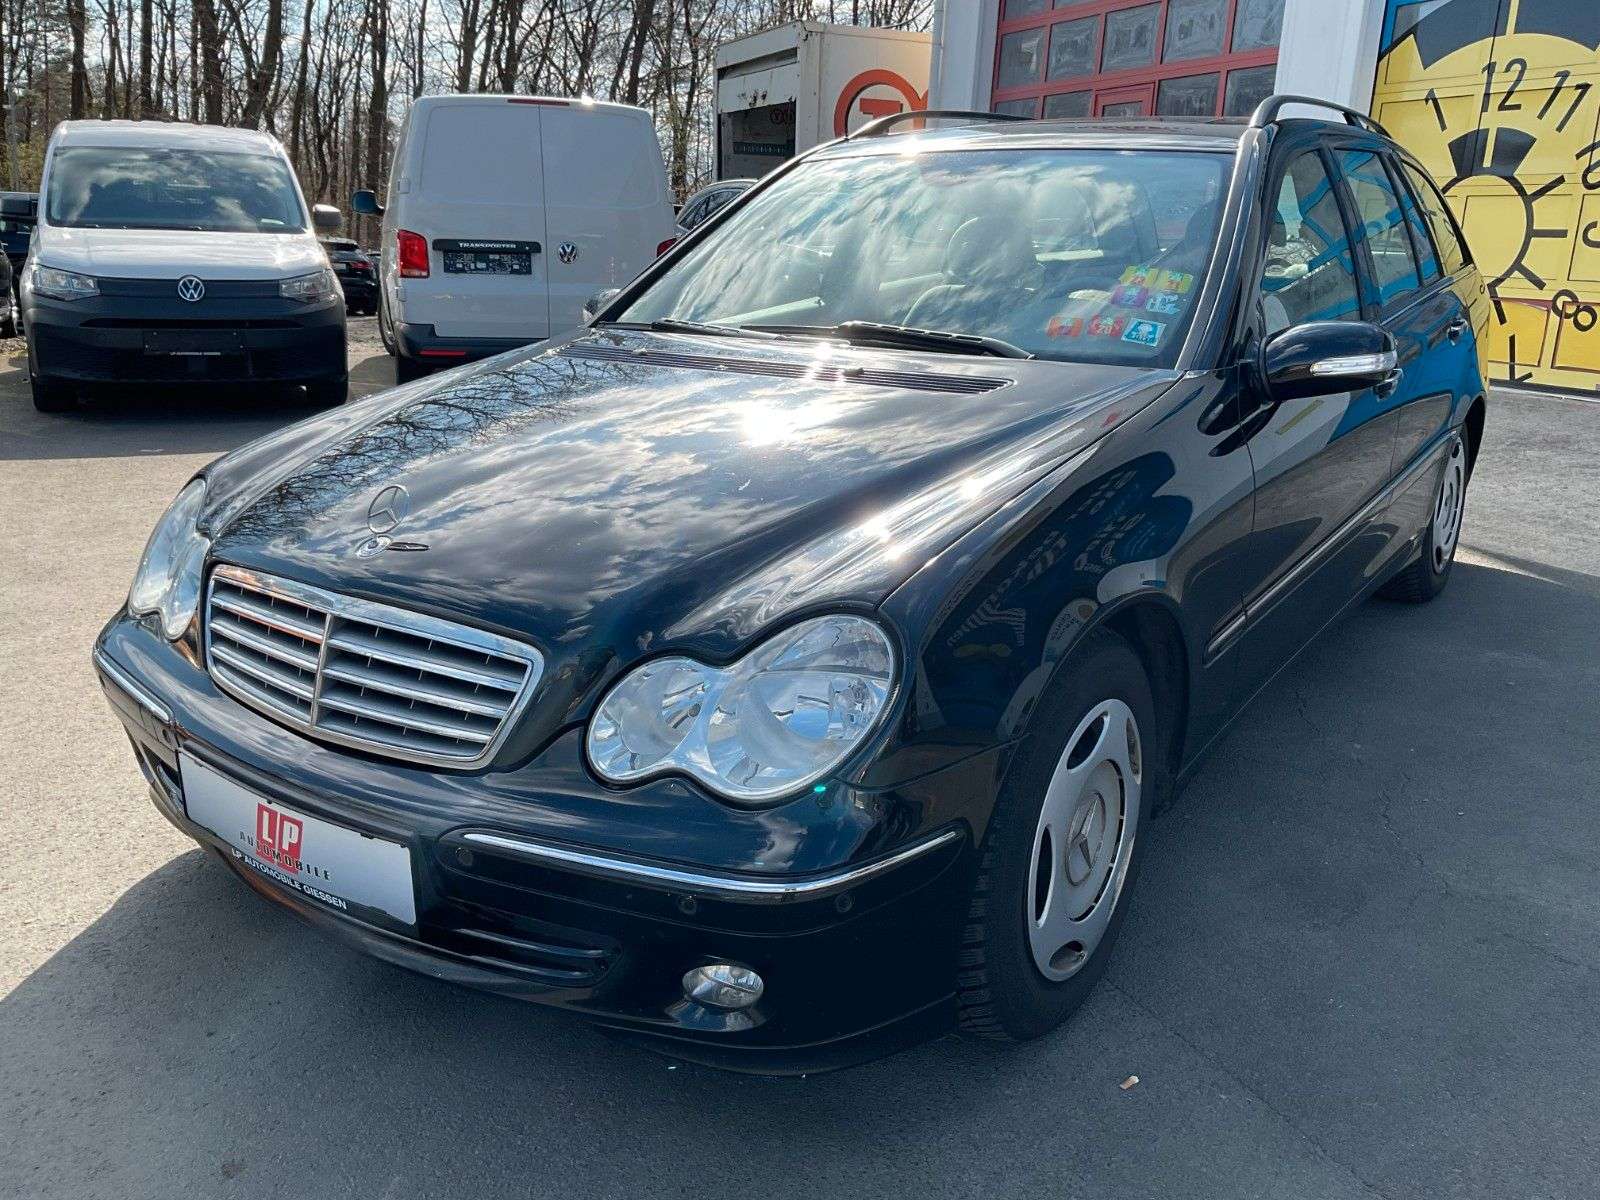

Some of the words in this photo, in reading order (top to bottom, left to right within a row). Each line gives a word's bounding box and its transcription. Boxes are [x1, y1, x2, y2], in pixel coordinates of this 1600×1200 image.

[1425, 88, 1447, 132] 1
[1481, 58, 1528, 113] 12
[1537, 70, 1593, 133] 11
[239, 830, 331, 882] AUTOMOBILE
[261, 810, 299, 851] LP
[231, 848, 244, 859] LP
[244, 855, 302, 891] AUTOMOBILE
[303, 883, 348, 910] GIESSEN
